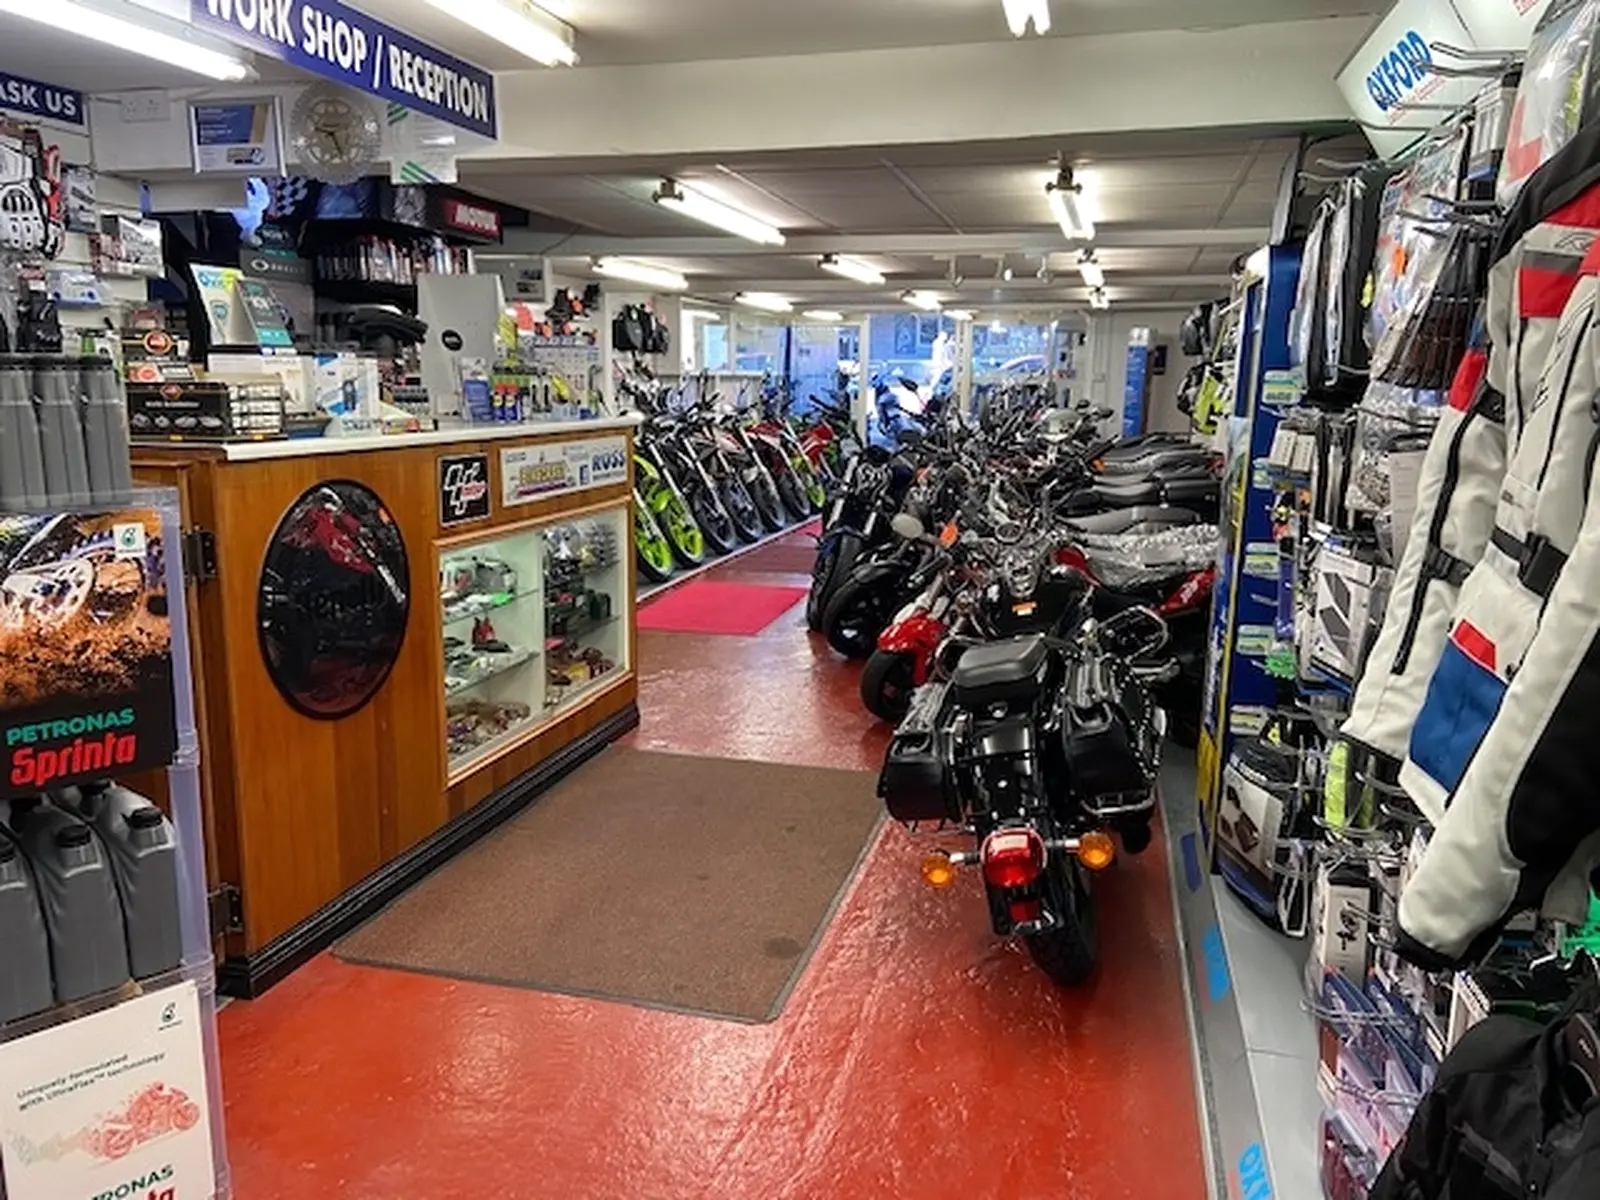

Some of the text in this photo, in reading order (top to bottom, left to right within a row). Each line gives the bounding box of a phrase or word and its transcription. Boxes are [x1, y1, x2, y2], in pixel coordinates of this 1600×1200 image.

[301, 5, 367, 73] SHOP
[373, 35, 383, 89] /
[389, 44, 489, 123] RECEPTION
[1366, 31, 1432, 111] OXFORD
[45, 90, 76, 116] US
[6, 708, 136, 746] PETRONAS
[11, 731, 137, 786] Sprinta
